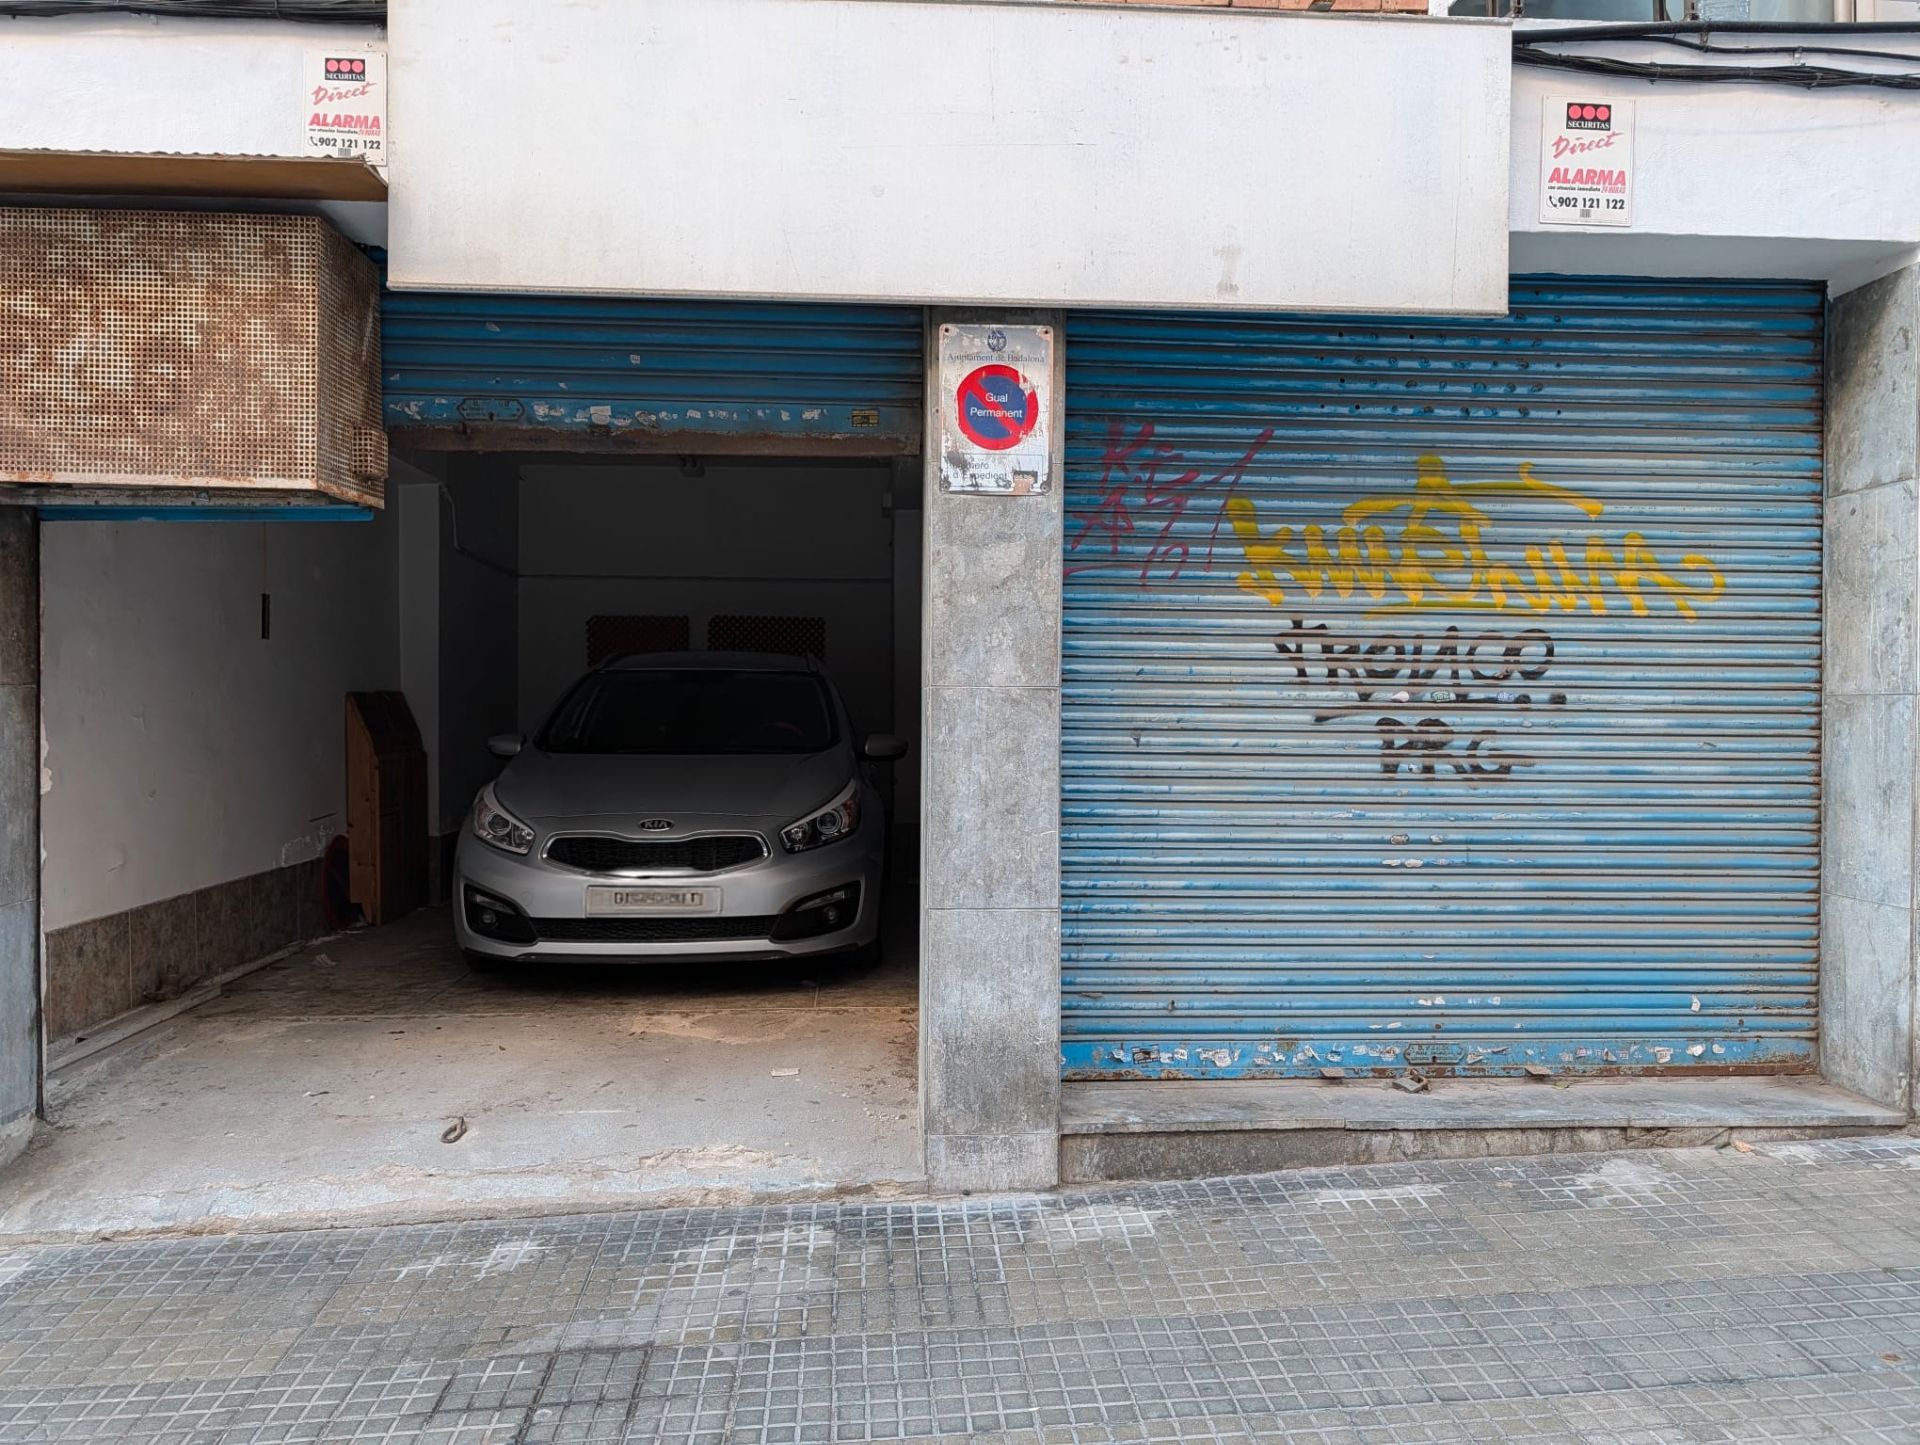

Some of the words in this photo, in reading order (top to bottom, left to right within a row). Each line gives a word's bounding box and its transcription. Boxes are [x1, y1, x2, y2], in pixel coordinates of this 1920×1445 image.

[312, 81, 377, 106] Direct
[308, 112, 381, 129] ALARMA
[1568, 121, 1610, 129] SECURITAS
[318, 137, 337, 147] 902
[341, 138, 358, 148] 121
[363, 140, 381, 149] 122
[1552, 131, 1624, 159] Direct
[1548, 167, 1626, 186] ALARMA
[1558, 196, 1578, 207] 902
[1582, 197, 1600, 208] 121
[1606, 198, 1625, 209] 122
[985, 392, 1008, 403] Gual
[970, 407, 1023, 419] Permanent
